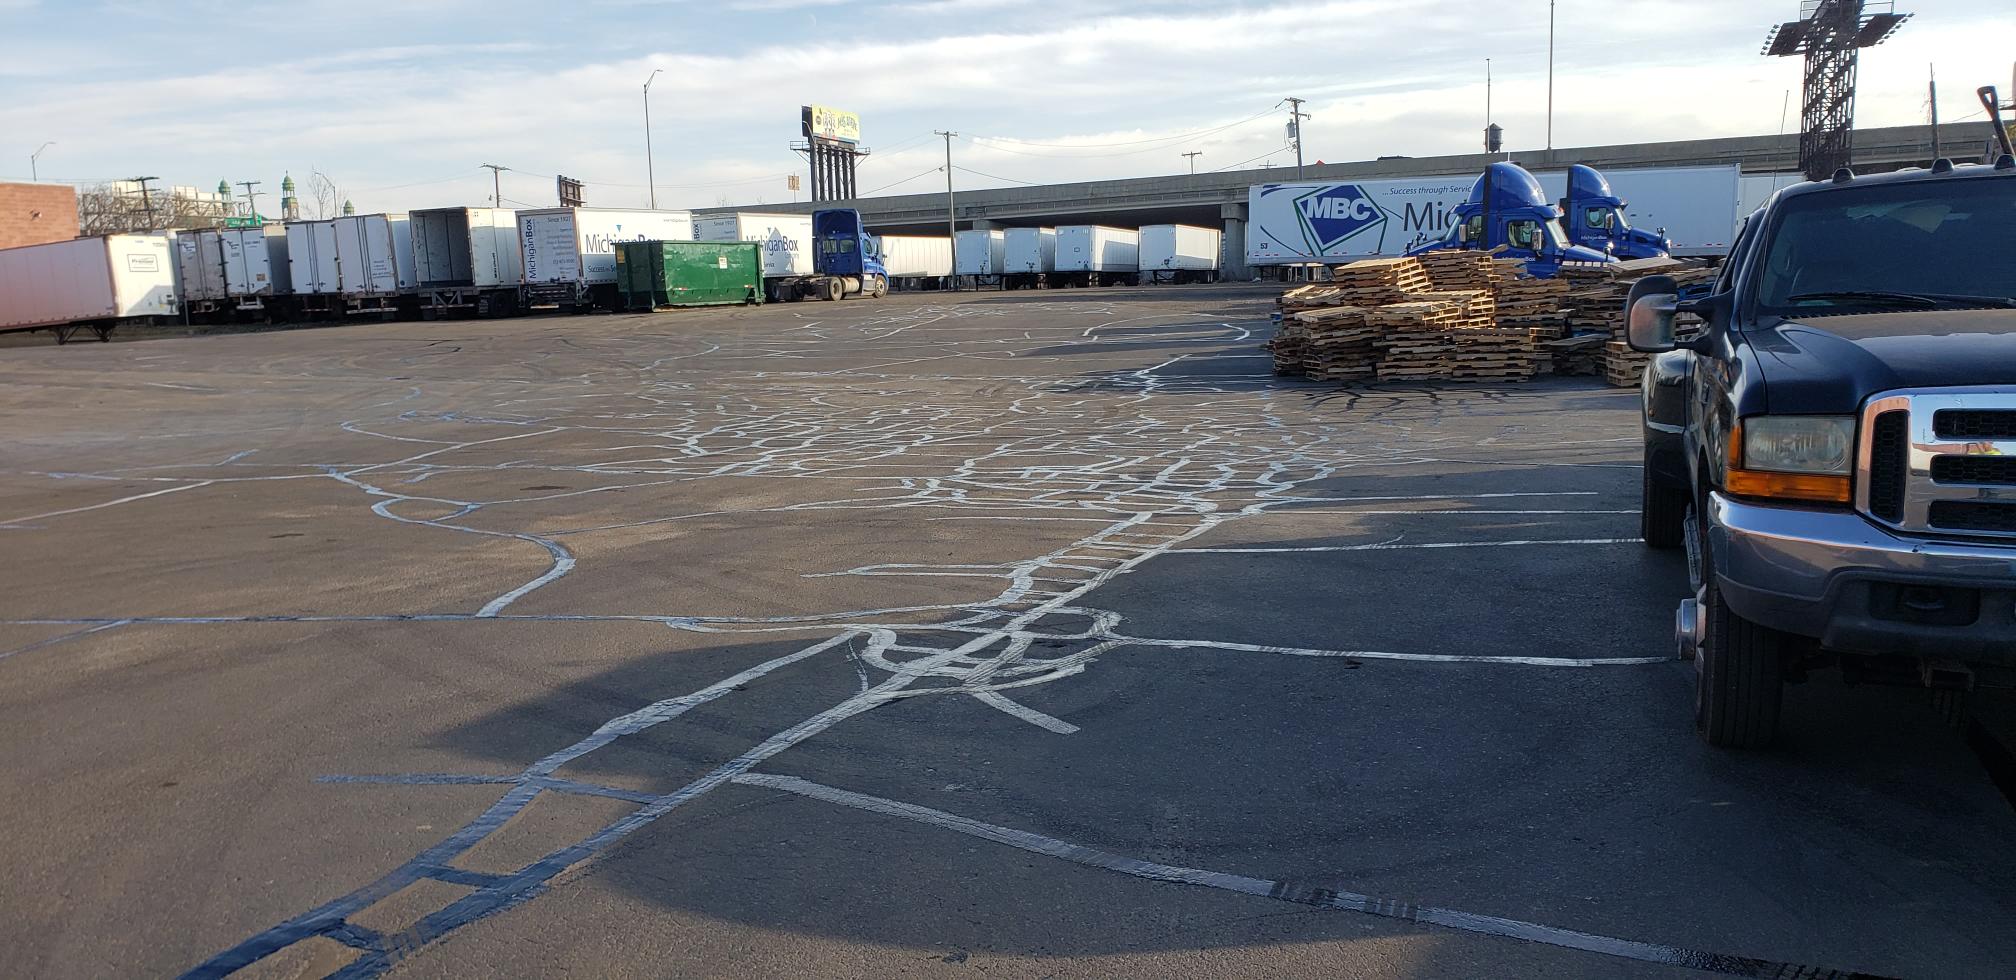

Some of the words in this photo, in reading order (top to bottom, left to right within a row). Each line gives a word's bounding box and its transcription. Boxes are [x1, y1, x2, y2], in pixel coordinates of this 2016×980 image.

[1418, 186, 1448, 195] through
[1306, 197, 1371, 221] MBC
[525, 218, 537, 279] MichiganBox
